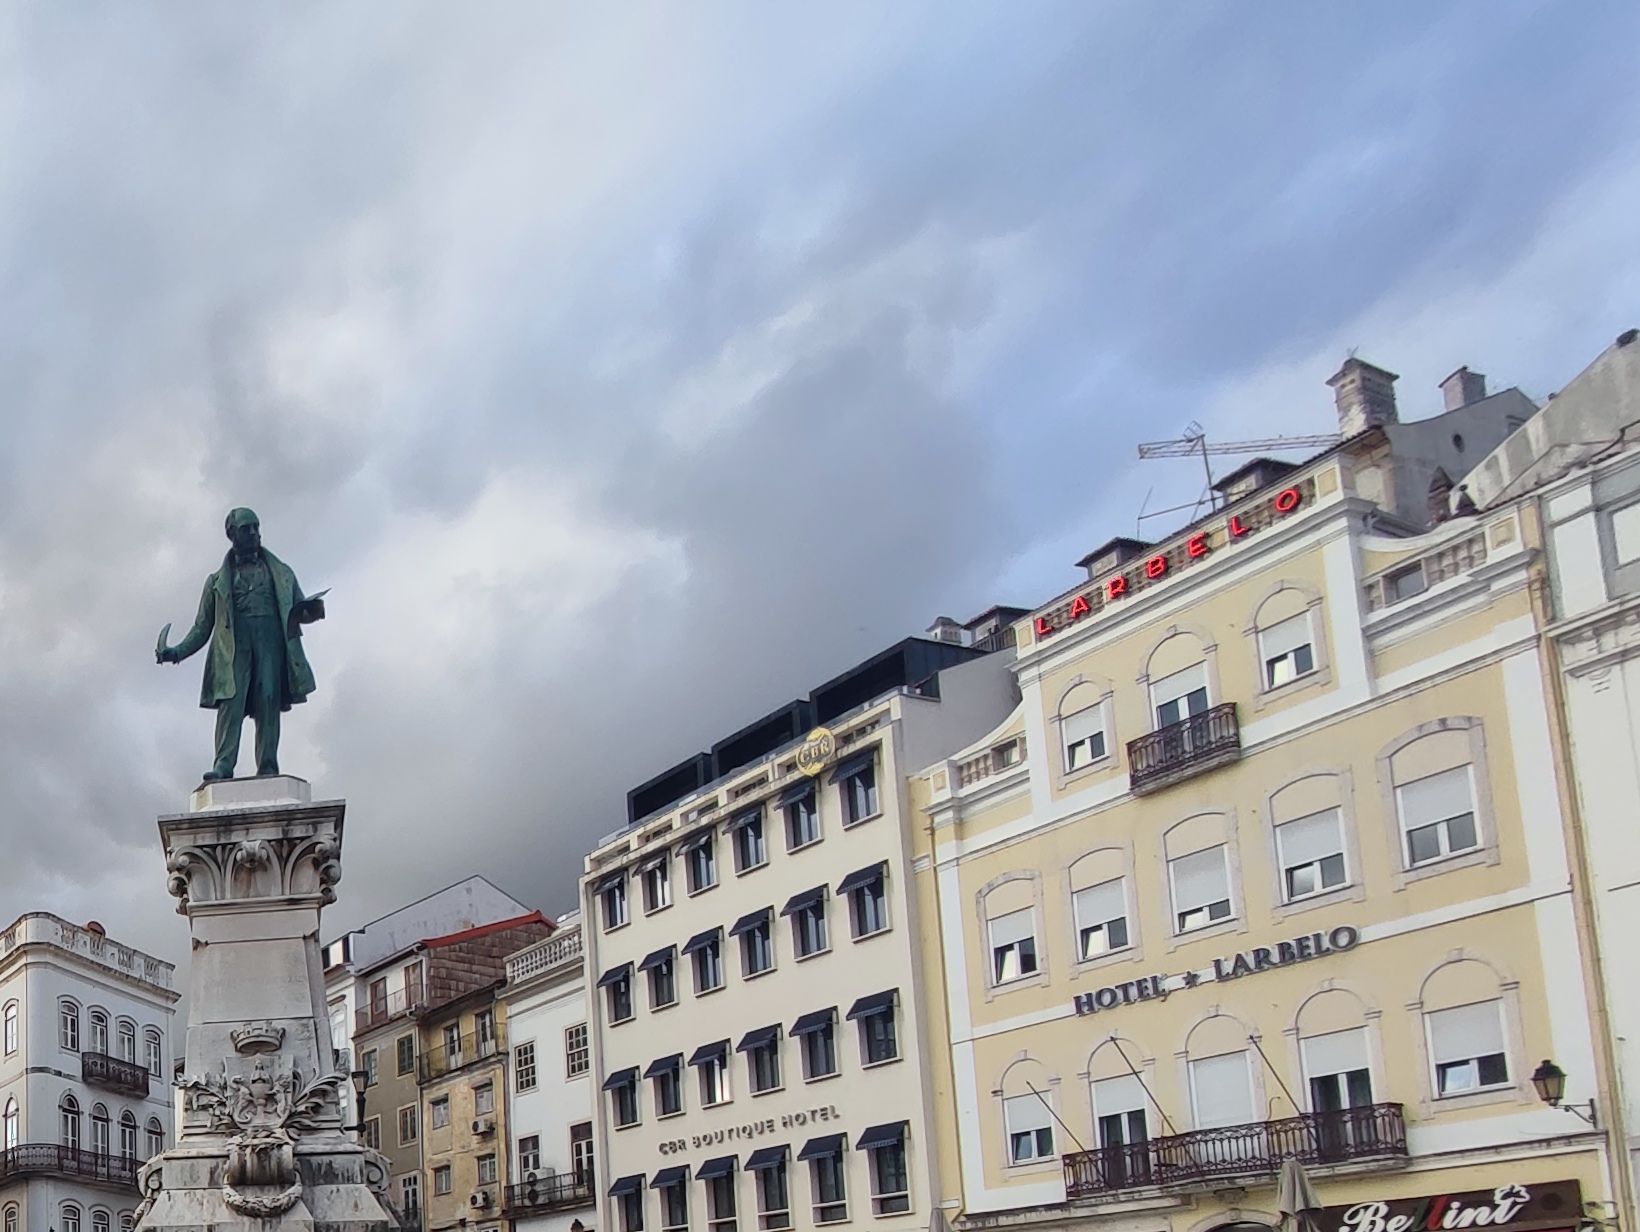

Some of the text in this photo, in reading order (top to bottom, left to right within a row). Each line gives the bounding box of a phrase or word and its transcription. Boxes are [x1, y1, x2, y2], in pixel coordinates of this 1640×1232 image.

[1036, 486, 1300, 636] LARBELO
[800, 739, 829, 763] CBR
[1072, 925, 1359, 1017] HOTEL LARBELO
[658, 1104, 842, 1156] CBR BOUTIQUE HOTEL
